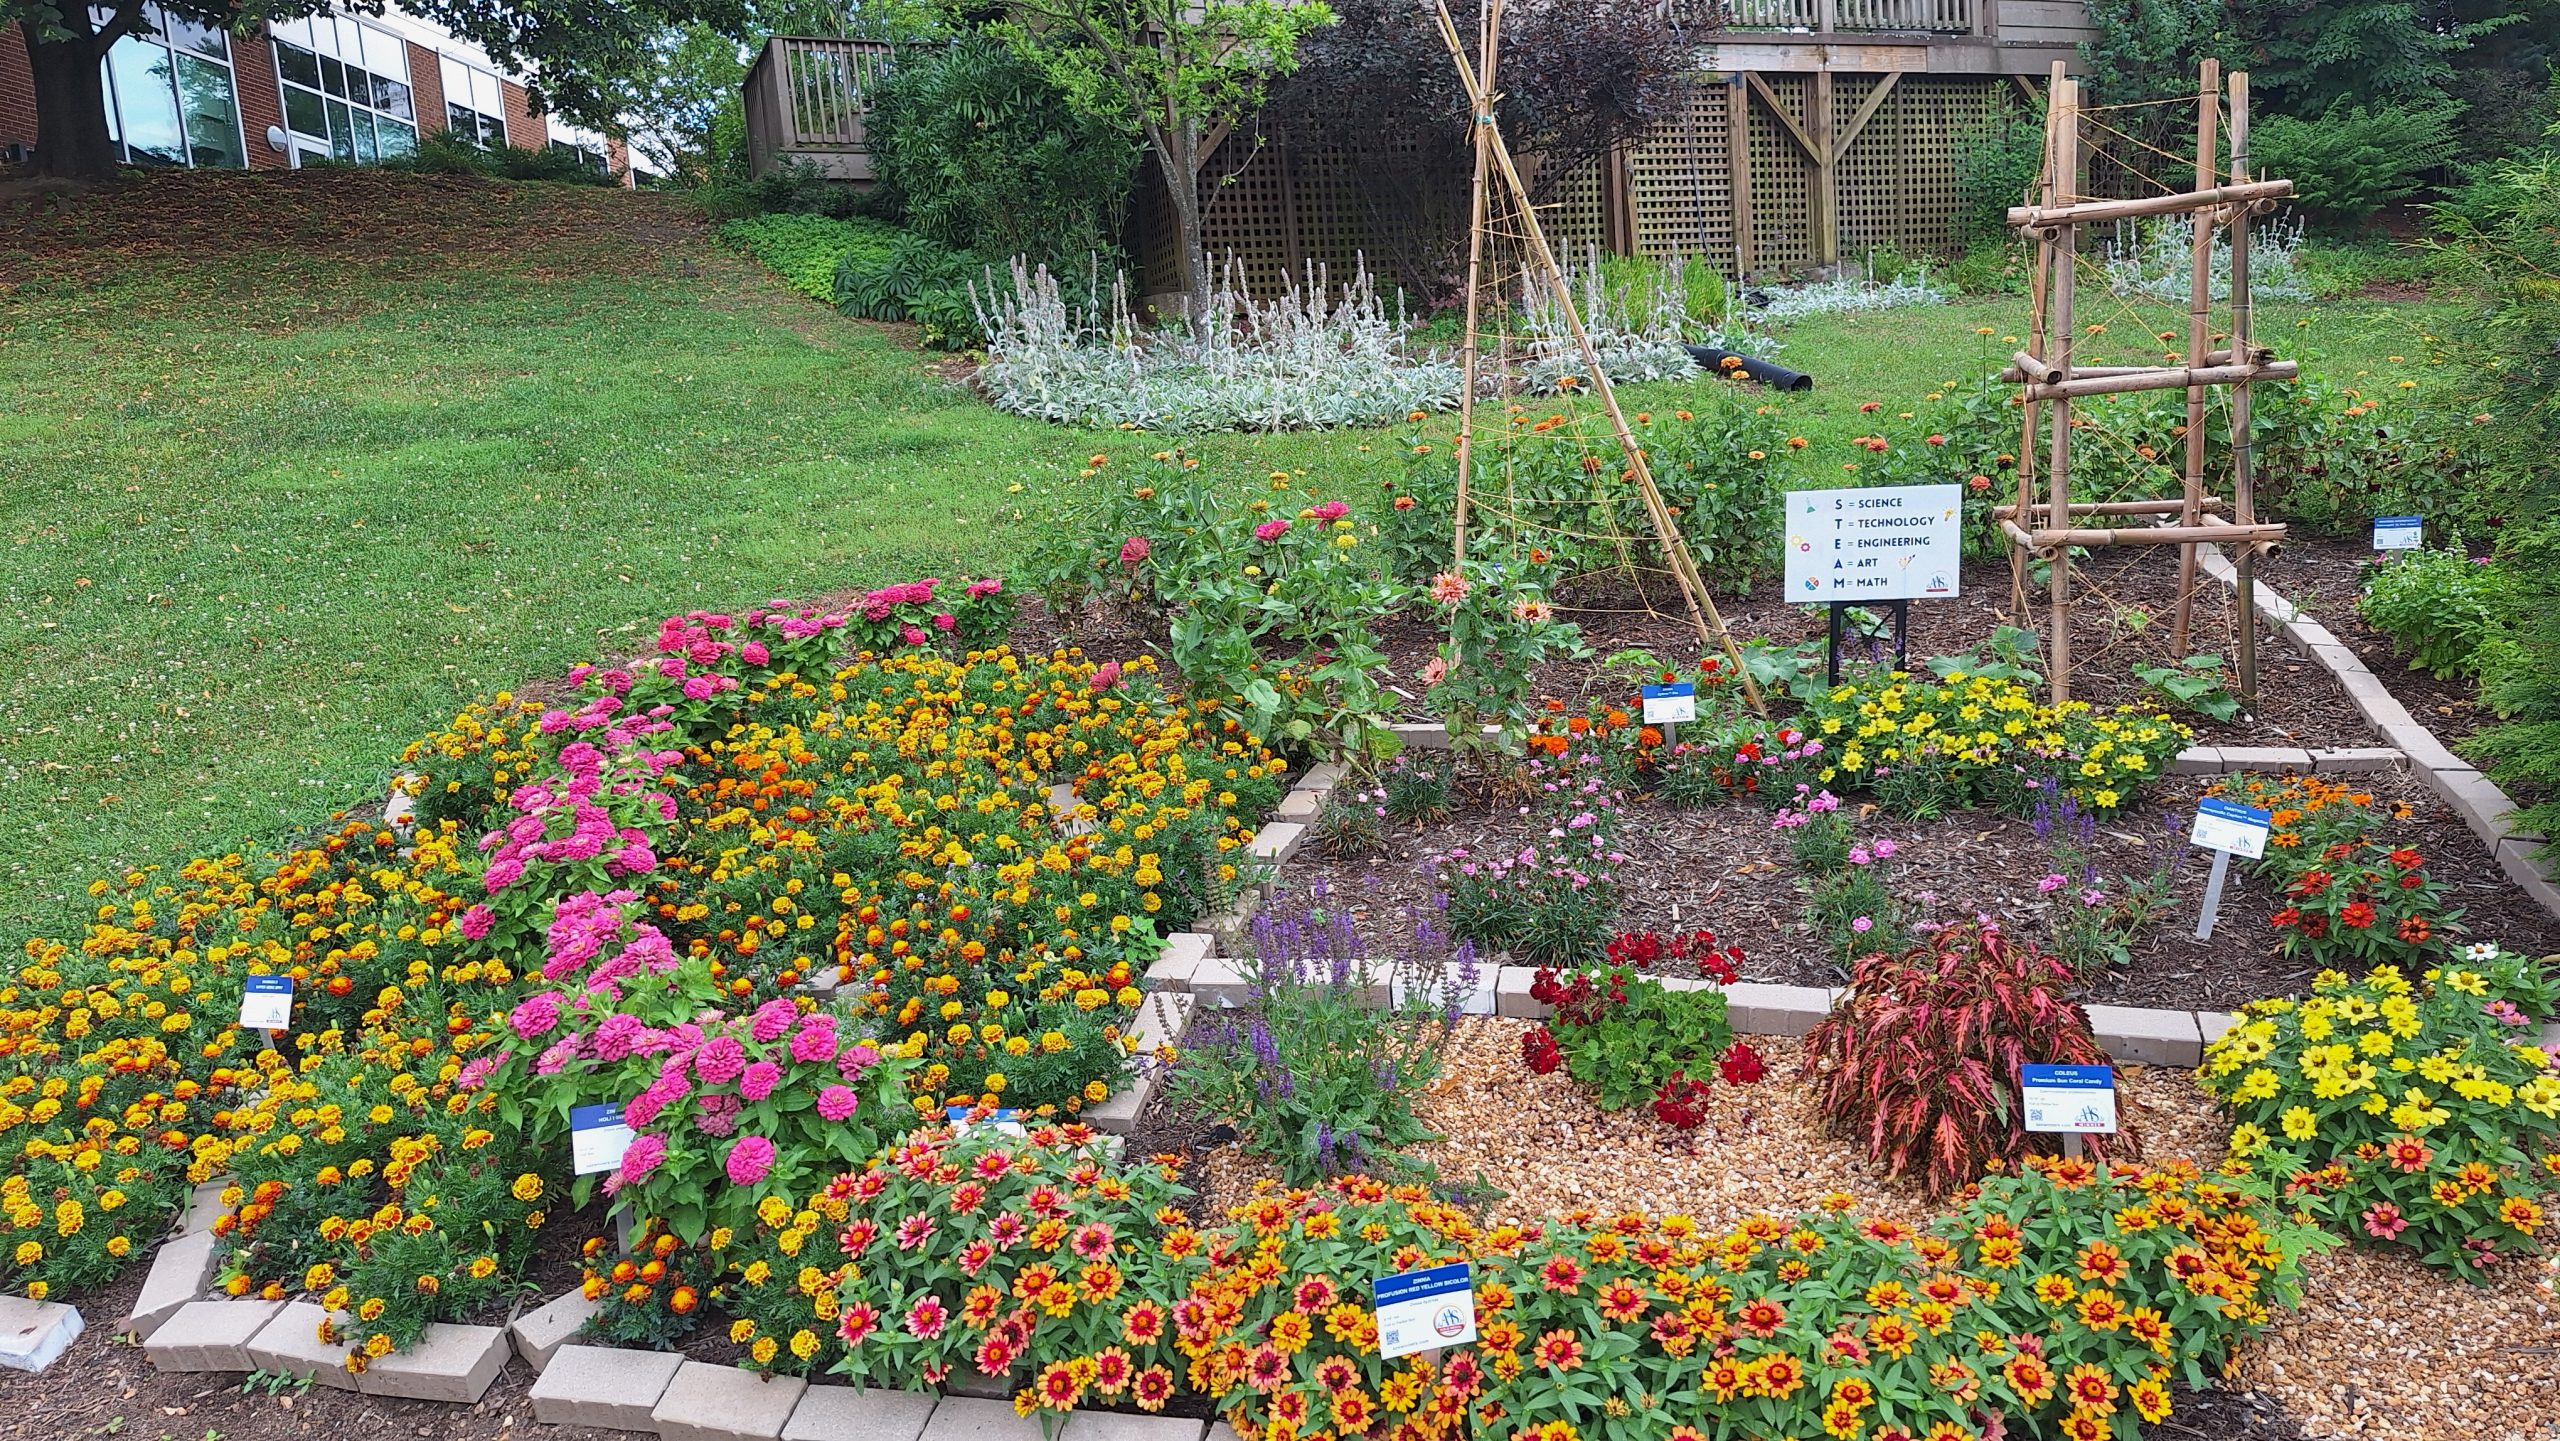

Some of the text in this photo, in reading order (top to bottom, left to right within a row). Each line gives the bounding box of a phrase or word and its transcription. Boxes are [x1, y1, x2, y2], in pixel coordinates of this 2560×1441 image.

[1835, 499, 1843, 510] S
[1858, 498, 1903, 509] SCIENCE
[1834, 518, 1843, 529] T
[1857, 516, 1935, 528] TECHNOLOGY
[1834, 538, 1841, 550] E
[1857, 536, 1931, 548] ENGINEERING
[1833, 558, 1843, 569] A
[1856, 558, 1878, 568] ART
[1833, 577, 1845, 588] M
[1856, 577, 1888, 587] MATH
[1413, 1276, 1431, 1284] ZINNIA
[1376, 1277, 1469, 1300] PROFUSION RED YELLOW BICOLOR
